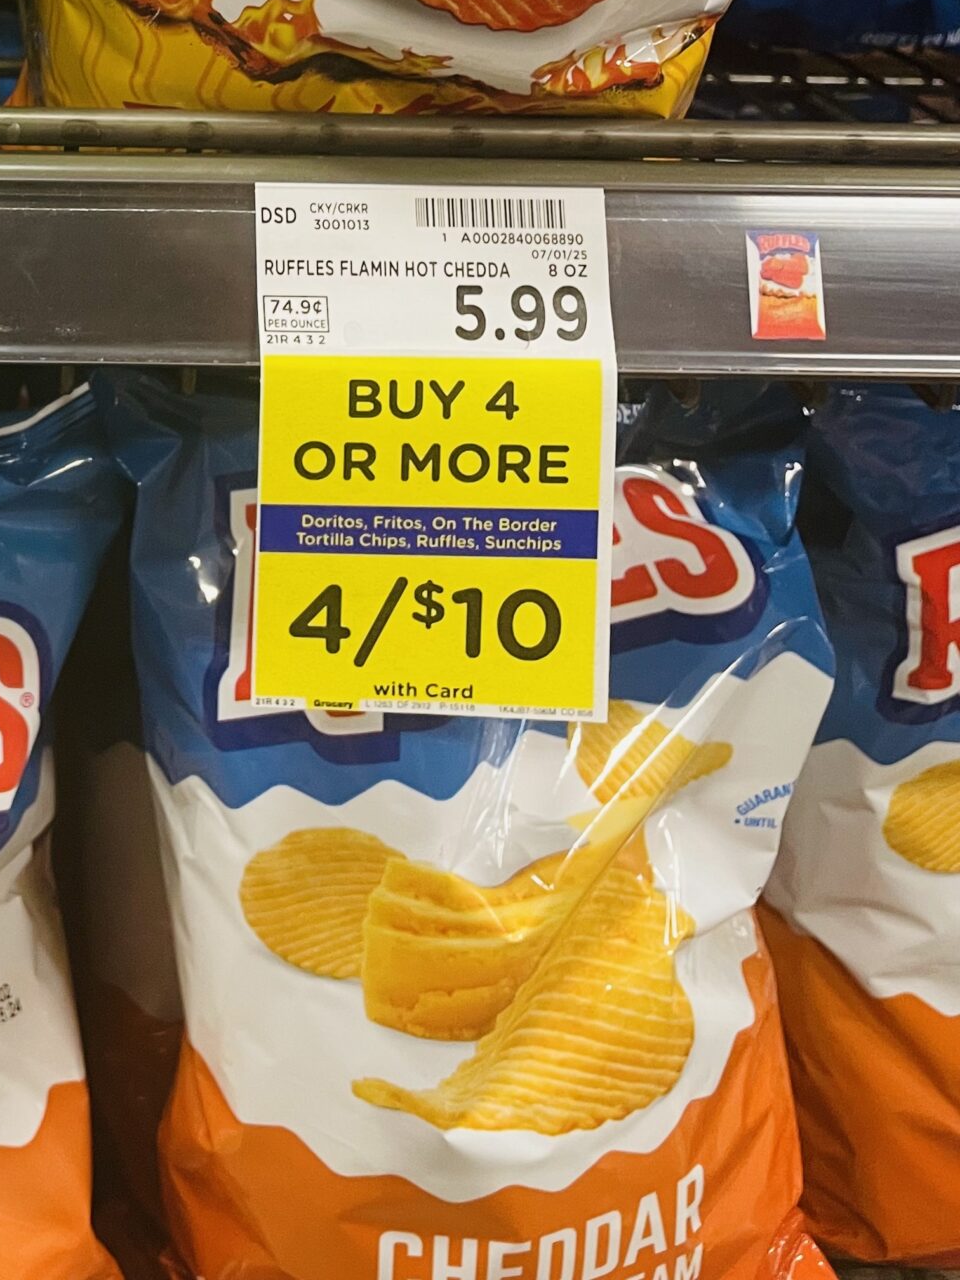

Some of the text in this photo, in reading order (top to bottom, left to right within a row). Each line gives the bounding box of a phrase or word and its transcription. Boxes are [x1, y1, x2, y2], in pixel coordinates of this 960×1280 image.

[261, 207, 297, 225] DSD
[309, 202, 368, 215] CKY/CRKR
[314, 219, 370, 231] 3001013
[461, 232, 584, 245] A0002840068890
[531, 250, 588, 261] 07/01/25
[264, 260, 510, 278] RUFFLES FLAMIN HOT CHEDDA
[548, 264, 588, 277] 8 OZ
[270, 299, 322, 315] 74.9¢
[455, 284, 587, 342] 5.99
[268, 319, 326, 329] PER OUNCE
[267, 334, 326, 345] 21R 4 3 2
[349, 379, 519, 420] BUY 4
[294, 441, 569, 483] OR MORE
[301, 514, 557, 532] Doritos, Fritos, On The Border
[296, 532, 562, 552] Tortilla Chips, Ruffles, Sunchips
[289, 576, 562, 668] 4/$10
[374, 682, 473, 699] with Card
[314, 699, 353, 709] Grocery
[744, 817, 777, 829] UNTIL
[377, 1163, 704, 1280] CHEDDAR
